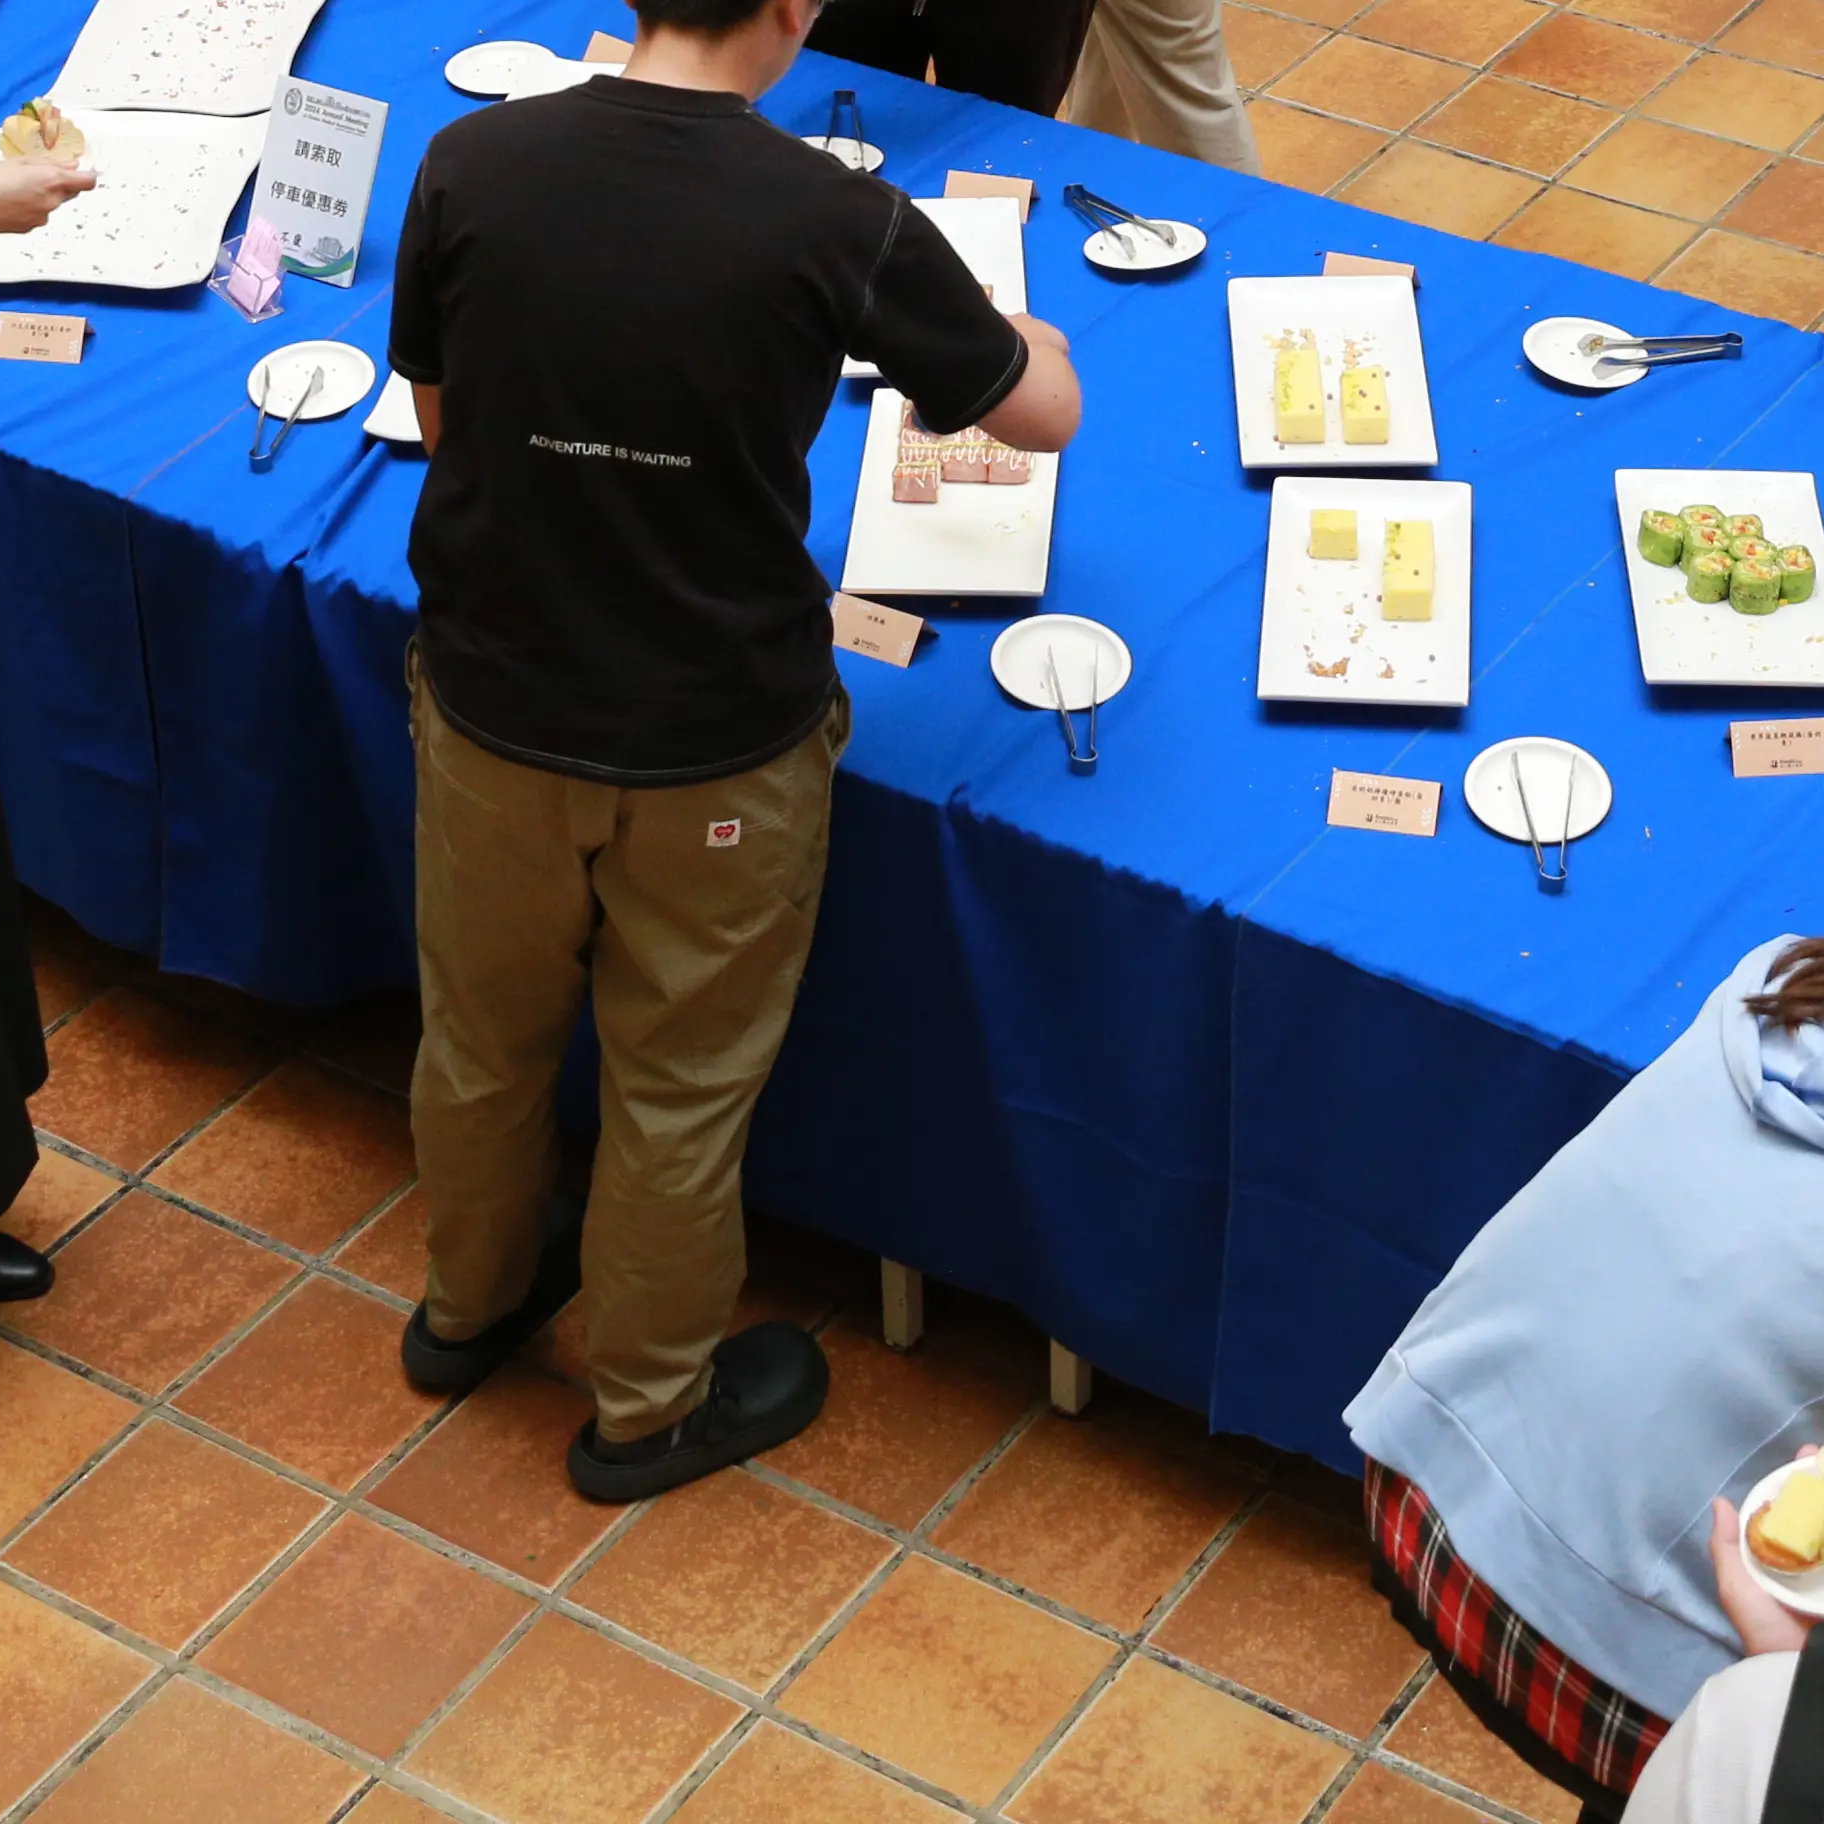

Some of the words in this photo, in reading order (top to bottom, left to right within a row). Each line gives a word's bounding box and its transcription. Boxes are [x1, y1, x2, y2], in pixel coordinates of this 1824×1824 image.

[295, 138, 342, 168] 請索取
[529, 434, 612, 457] ADVENTURE
[615, 447, 628, 459] IS
[631, 450, 692, 468] WAITING
